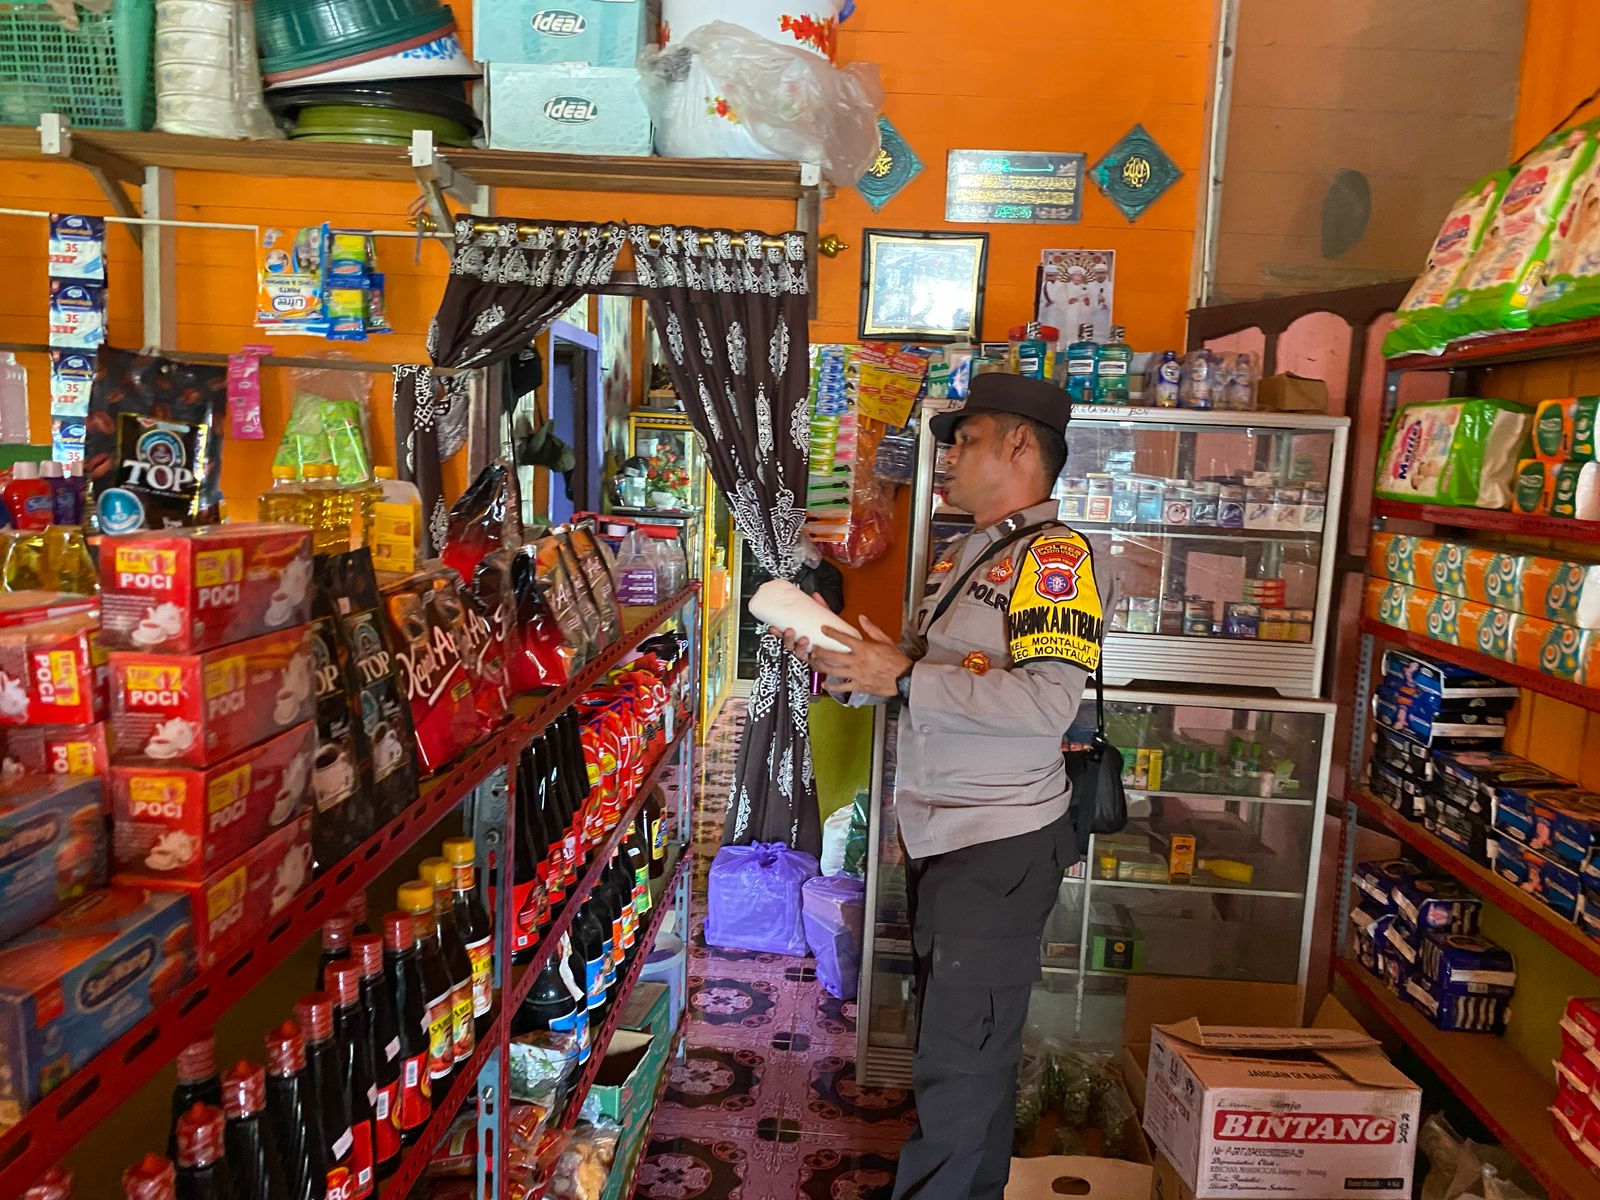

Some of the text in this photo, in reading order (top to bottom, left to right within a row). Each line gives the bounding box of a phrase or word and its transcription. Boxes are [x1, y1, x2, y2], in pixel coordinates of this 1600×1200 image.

[65, 243, 78, 253] 35
[277, 298, 303, 311] Lifree
[65, 313, 79, 323] 35
[65, 384, 79, 393] 35
[68, 452, 80, 461] 35
[1398, 420, 1422, 480] Merries
[122, 459, 194, 492] TOP
[120, 572, 173, 590] POCI
[198, 583, 240, 610] POCI
[1032, 636, 1091, 654] MONTALLAT
[1034, 646, 1097, 668] MONTALLAT
[357, 650, 390, 683] TOP
[34, 654, 56, 703] POCI
[316, 664, 339, 696] OP
[130, 690, 179, 706] POCI
[52, 746, 69, 773] PO
[134, 801, 183, 819] POCI
[1248, 1069, 1293, 1079] JANGAN
[1218, 1114, 1393, 1142] BINTANG
